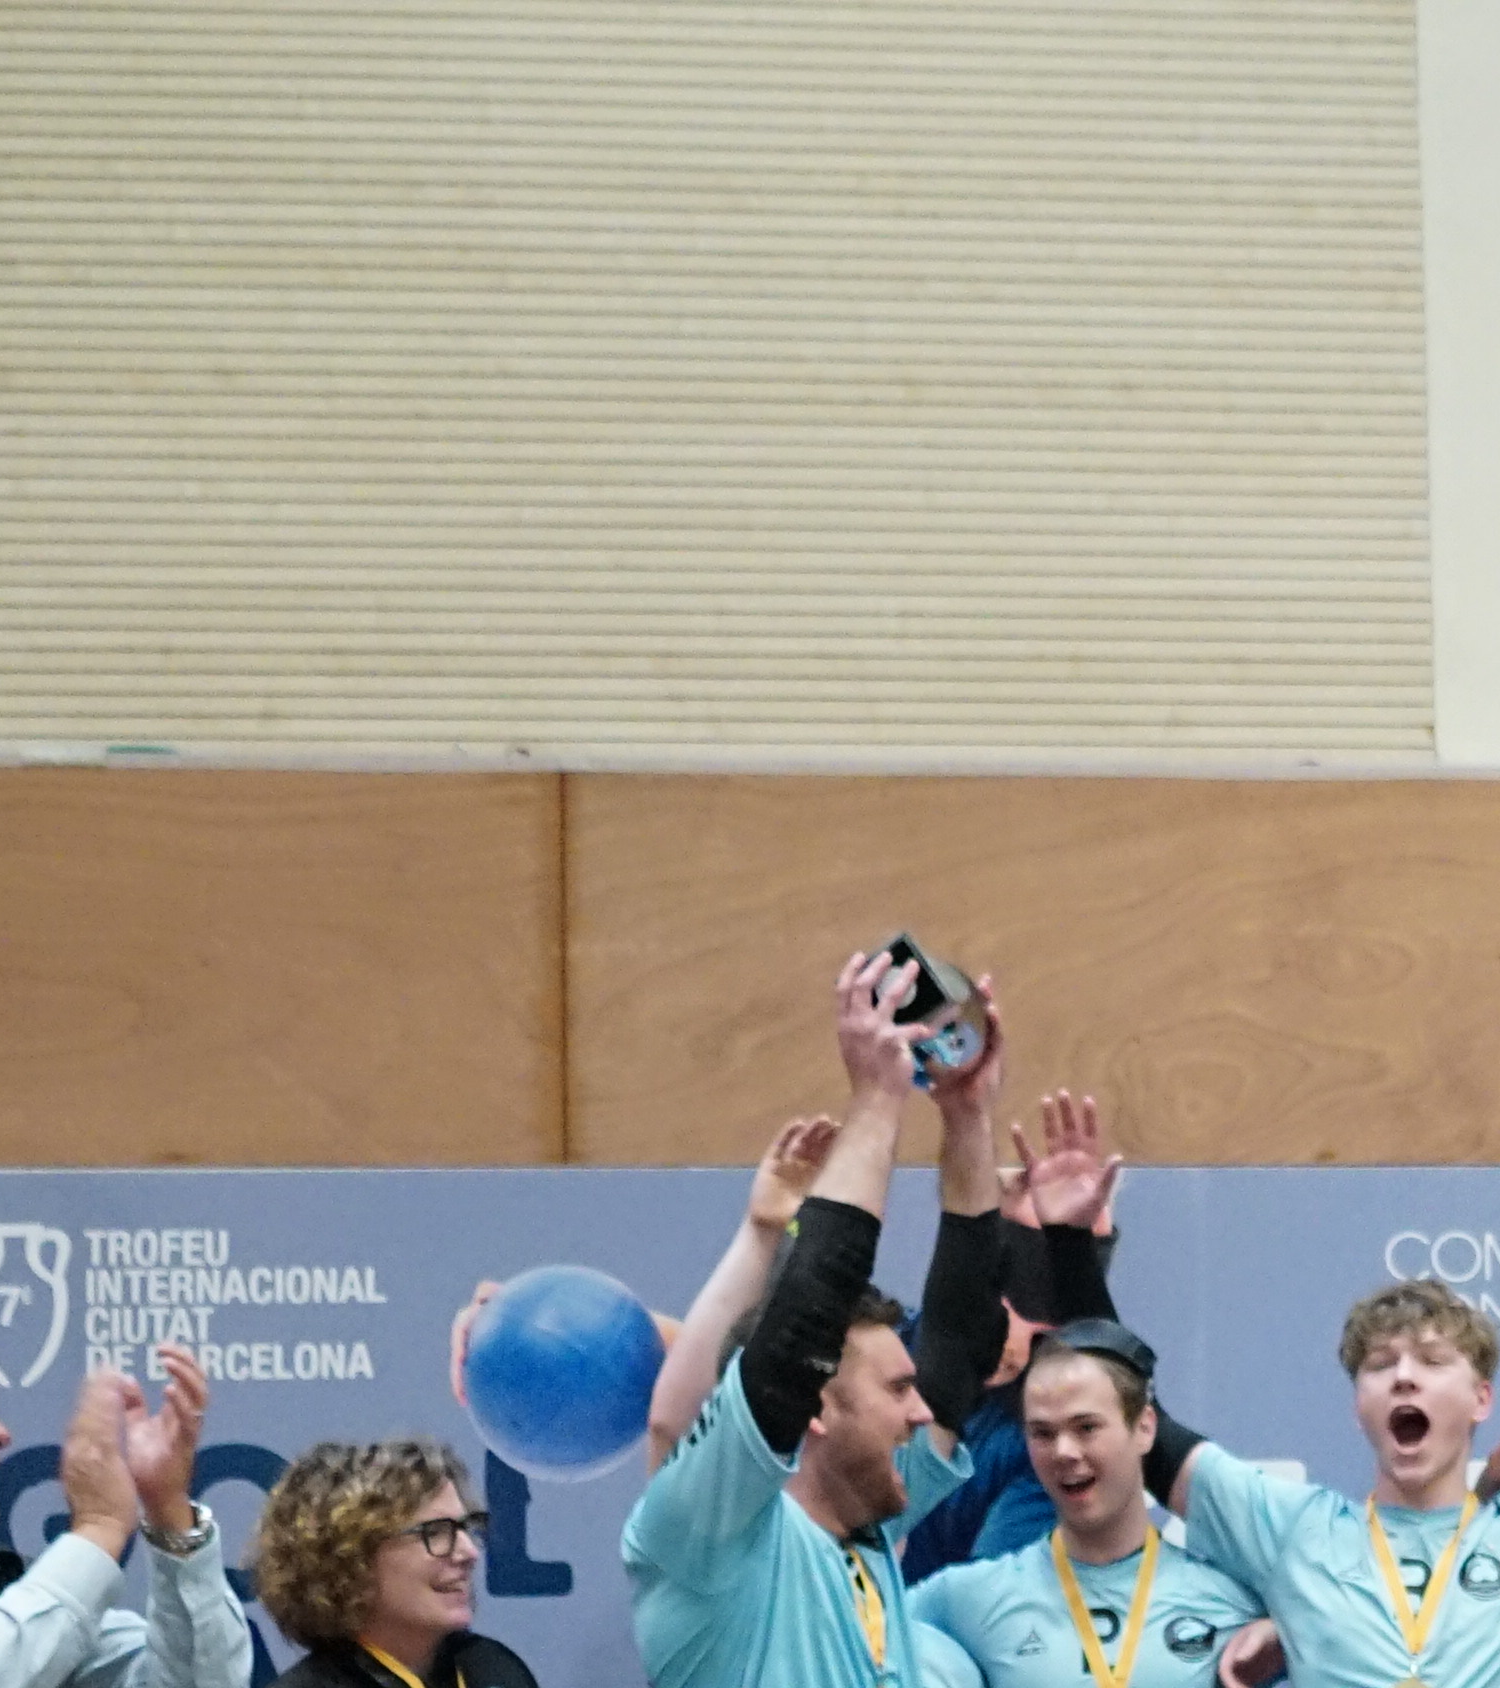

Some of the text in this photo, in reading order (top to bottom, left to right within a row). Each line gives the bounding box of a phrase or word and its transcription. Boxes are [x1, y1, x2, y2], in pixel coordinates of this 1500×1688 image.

[84, 1229, 230, 1268] TROFEU
[85, 1267, 388, 1304] INTERNACIONAL
[85, 1306, 214, 1345] CIUTAT
[85, 1342, 374, 1382] DE BRCELONA
